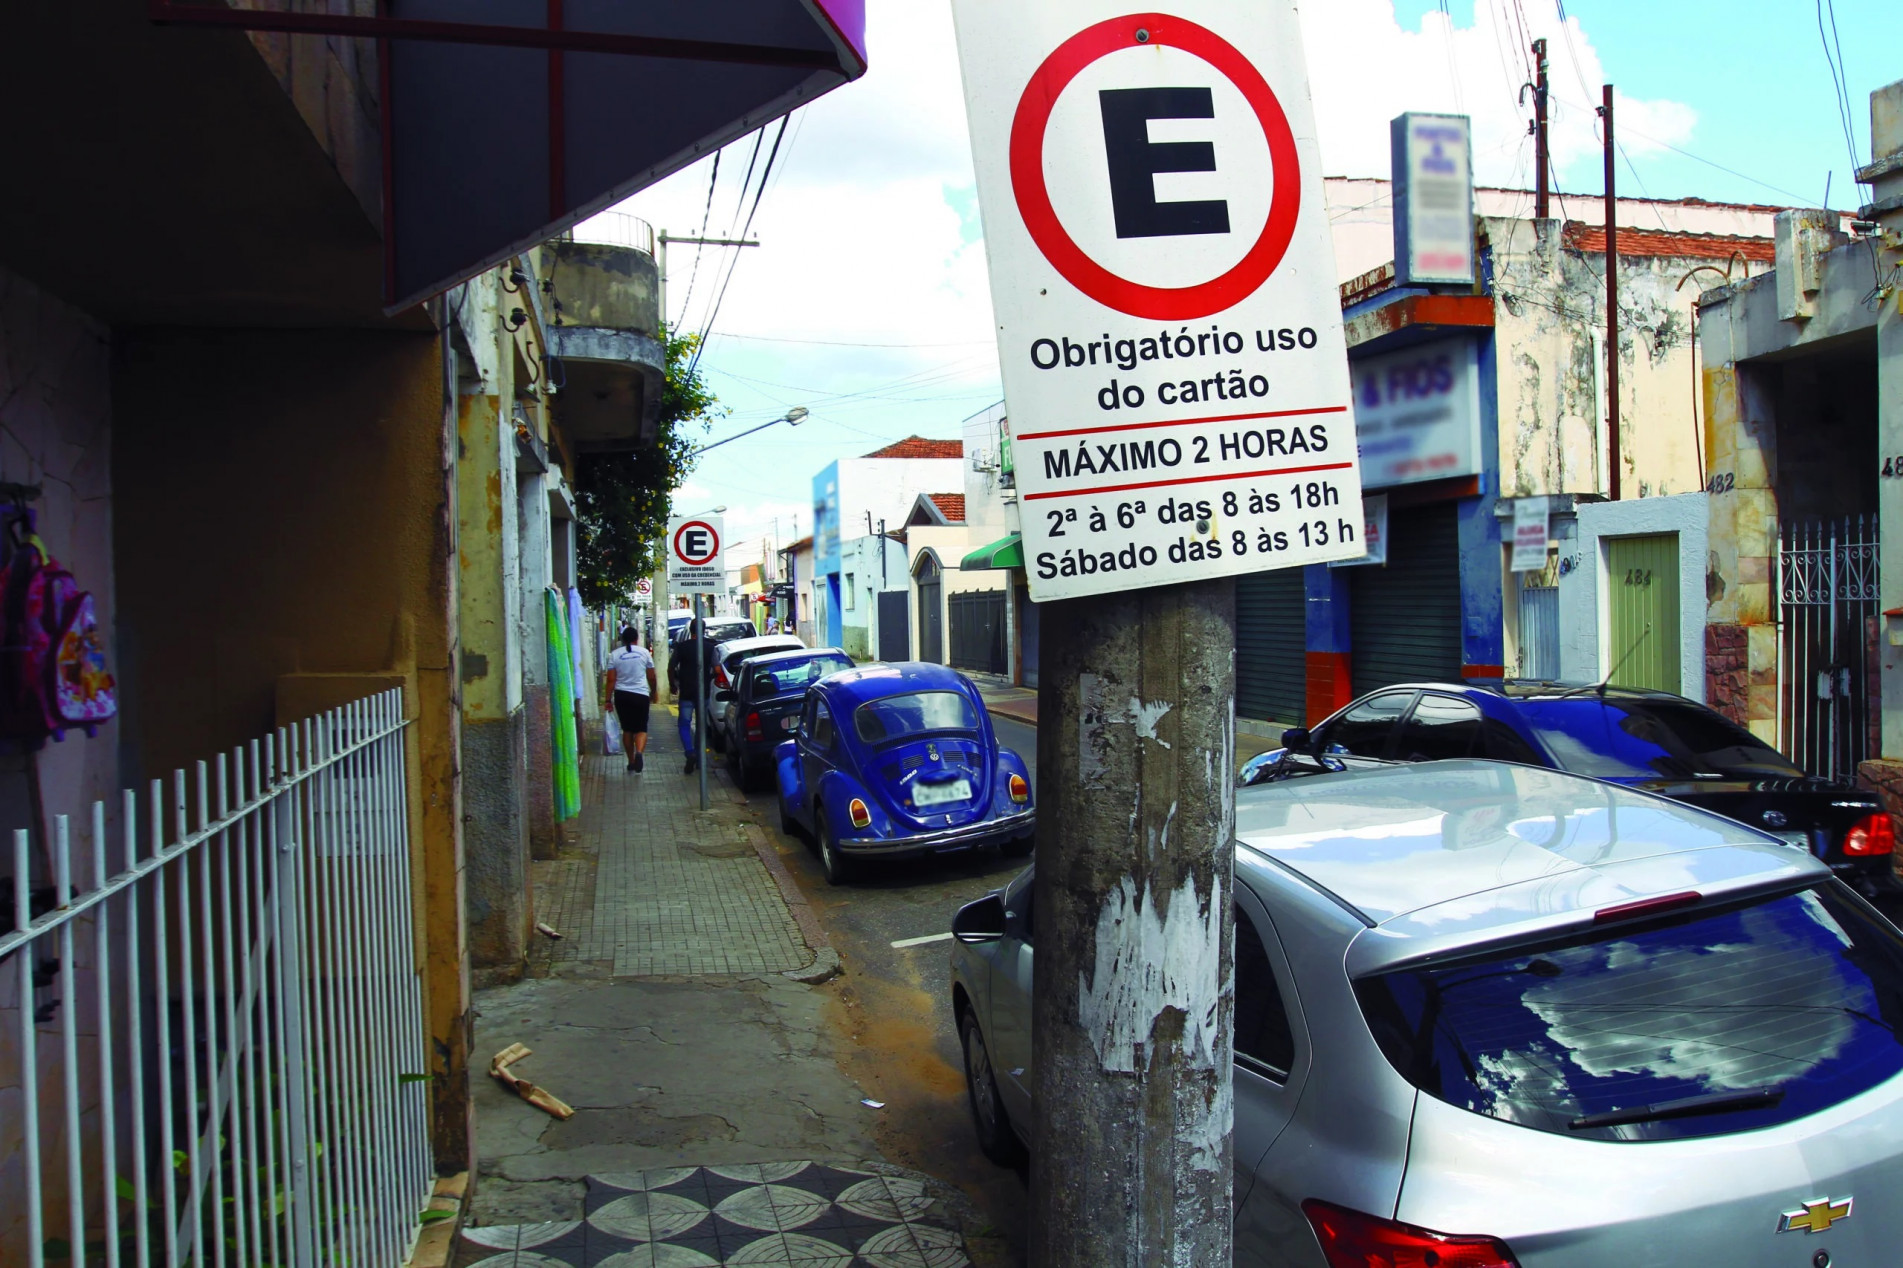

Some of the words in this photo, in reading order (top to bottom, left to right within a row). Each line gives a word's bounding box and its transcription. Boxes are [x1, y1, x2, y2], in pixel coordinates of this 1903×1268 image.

[1099, 87, 1231, 238] E
[1031, 327, 1243, 370] Obrigatório
[1256, 328, 1317, 352] uso
[1098, 379, 1144, 410] do
[1158, 369, 1270, 408] cartão
[1044, 439, 1181, 479] MÁXIMO
[1193, 436, 1209, 463] 2
[1220, 425, 1328, 460] HORAS
[1707, 472, 1735, 494] 482
[1047, 509, 1077, 537] 2ª
[1090, 504, 1106, 532] à
[1117, 500, 1146, 528] 6ª
[1158, 498, 1212, 524] das
[1223, 492, 1238, 516] 8
[1249, 488, 1280, 515] às
[1291, 482, 1338, 508] 18h
[686, 531, 707, 555] E
[1037, 543, 1157, 579] Sábado
[1168, 537, 1222, 563] das
[1232, 530, 1247, 555] 8
[1258, 526, 1288, 554] às
[1299, 521, 1328, 547] 13
[1338, 519, 1354, 542] h
